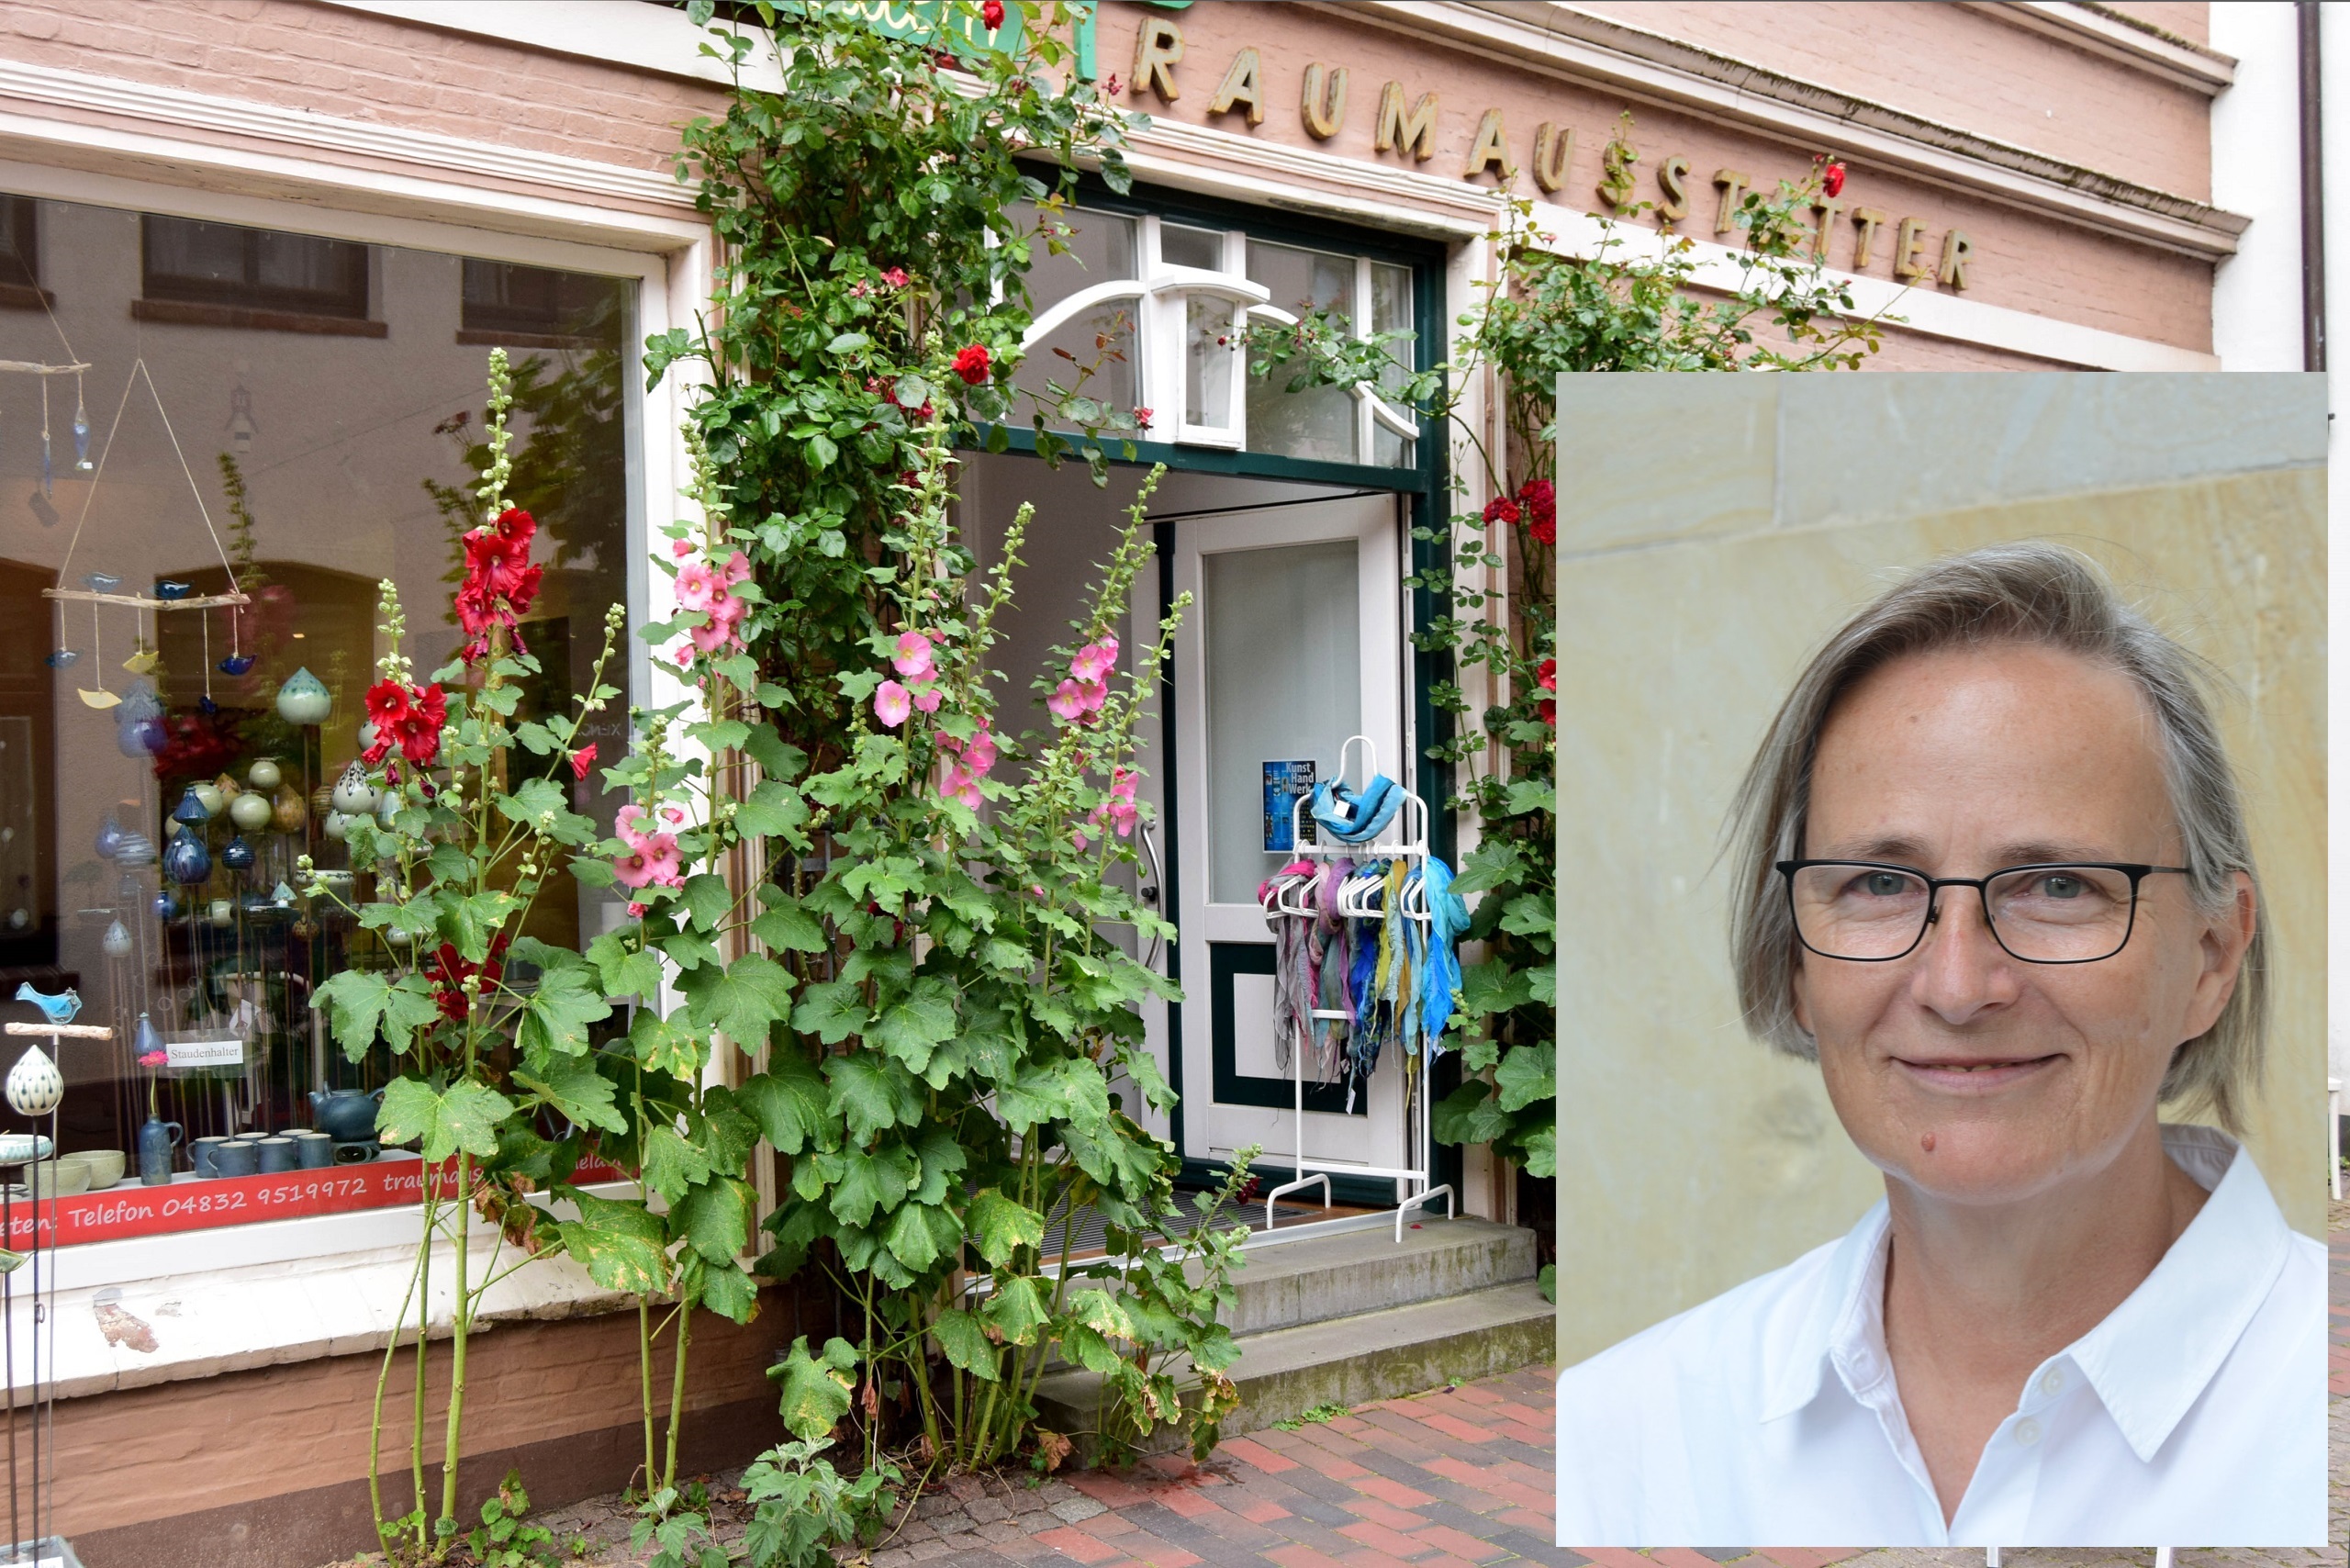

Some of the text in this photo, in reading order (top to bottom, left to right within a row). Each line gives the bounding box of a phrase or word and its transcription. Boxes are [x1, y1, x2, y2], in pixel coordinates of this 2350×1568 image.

[1286, 762, 1311, 773] Kunst
[1291, 772, 1315, 784] Hand
[1288, 783, 1312, 795] Werk
[171, 1047, 239, 1059] Staudenhalter
[67, 1199, 153, 1228] Telefon
[162, 1191, 248, 1216] 04832
[257, 1177, 367, 1205] 9519972
